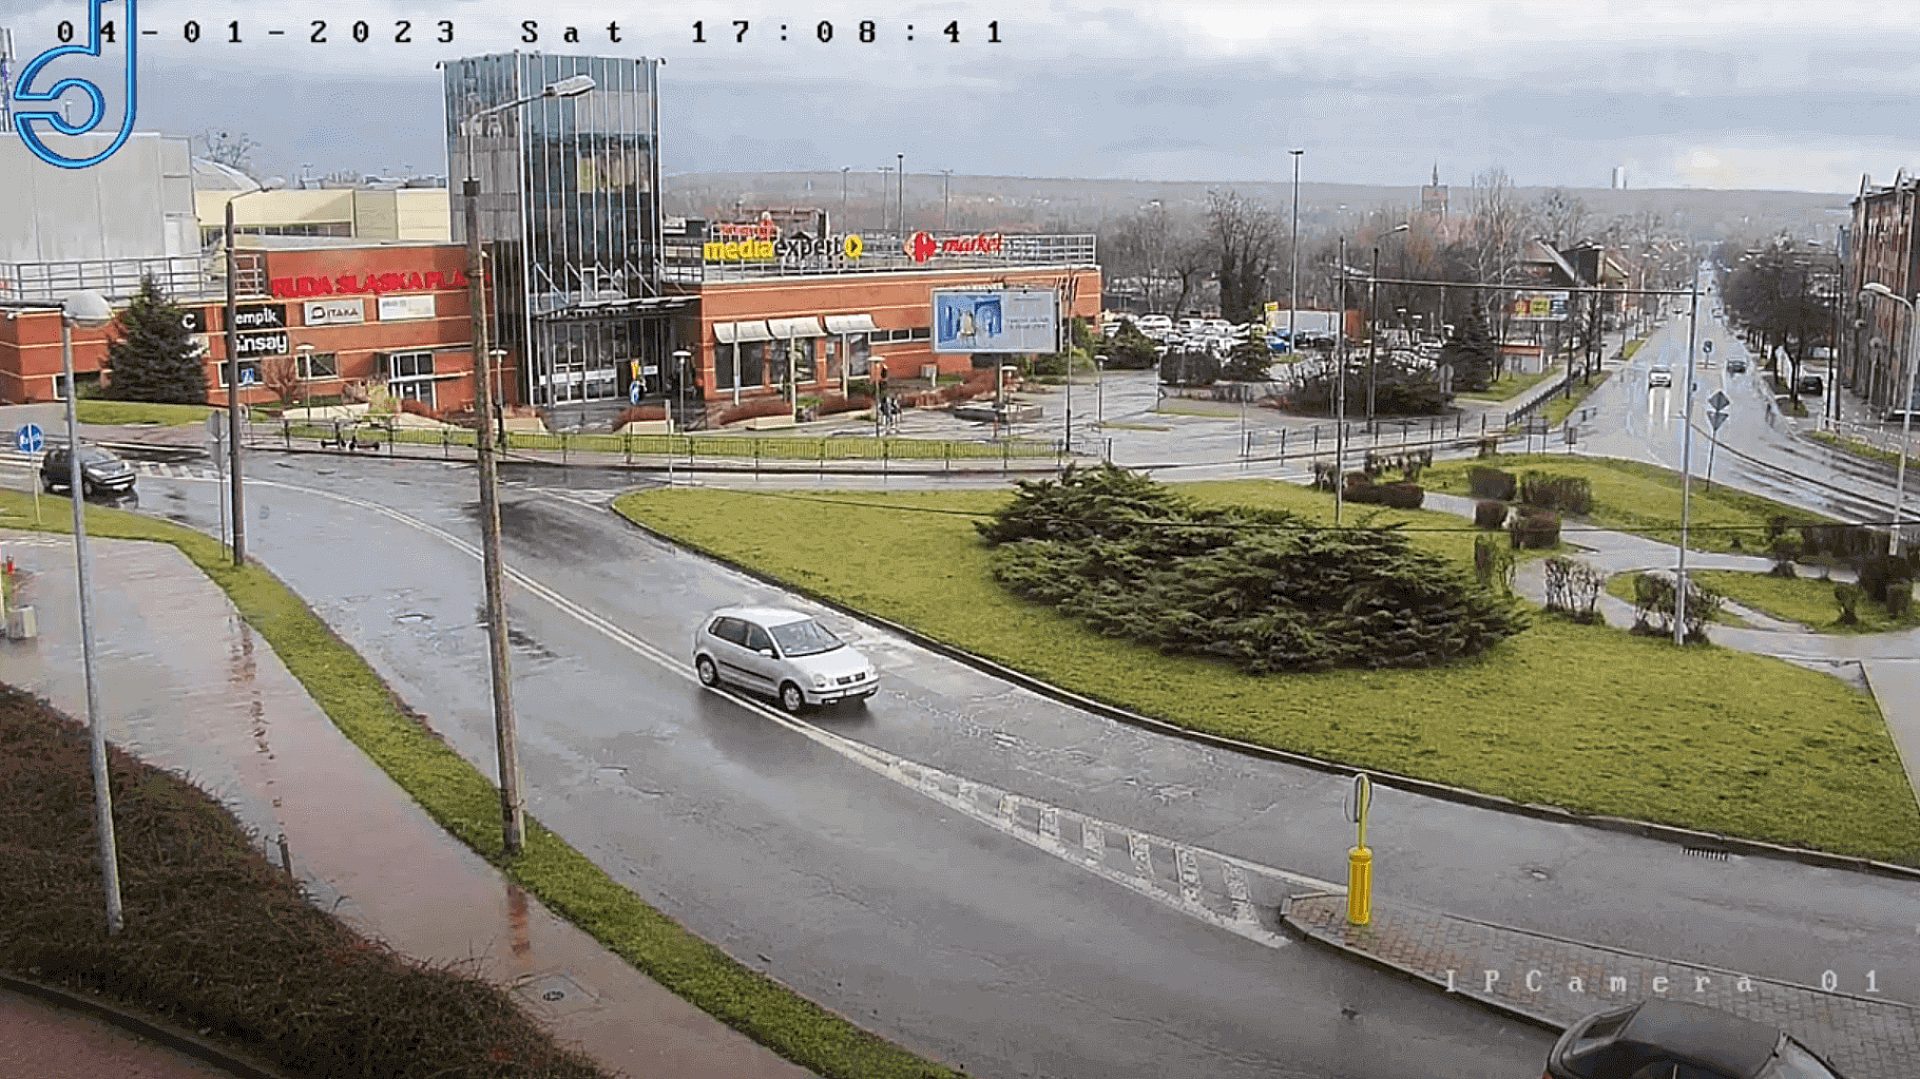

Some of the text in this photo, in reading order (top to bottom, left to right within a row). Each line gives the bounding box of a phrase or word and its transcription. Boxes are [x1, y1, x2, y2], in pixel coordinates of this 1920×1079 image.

[943, 235, 1003, 254] market
[272, 276, 333, 297] RUDA
[235, 307, 277, 326] empik
[327, 308, 358, 318] ITAKA
